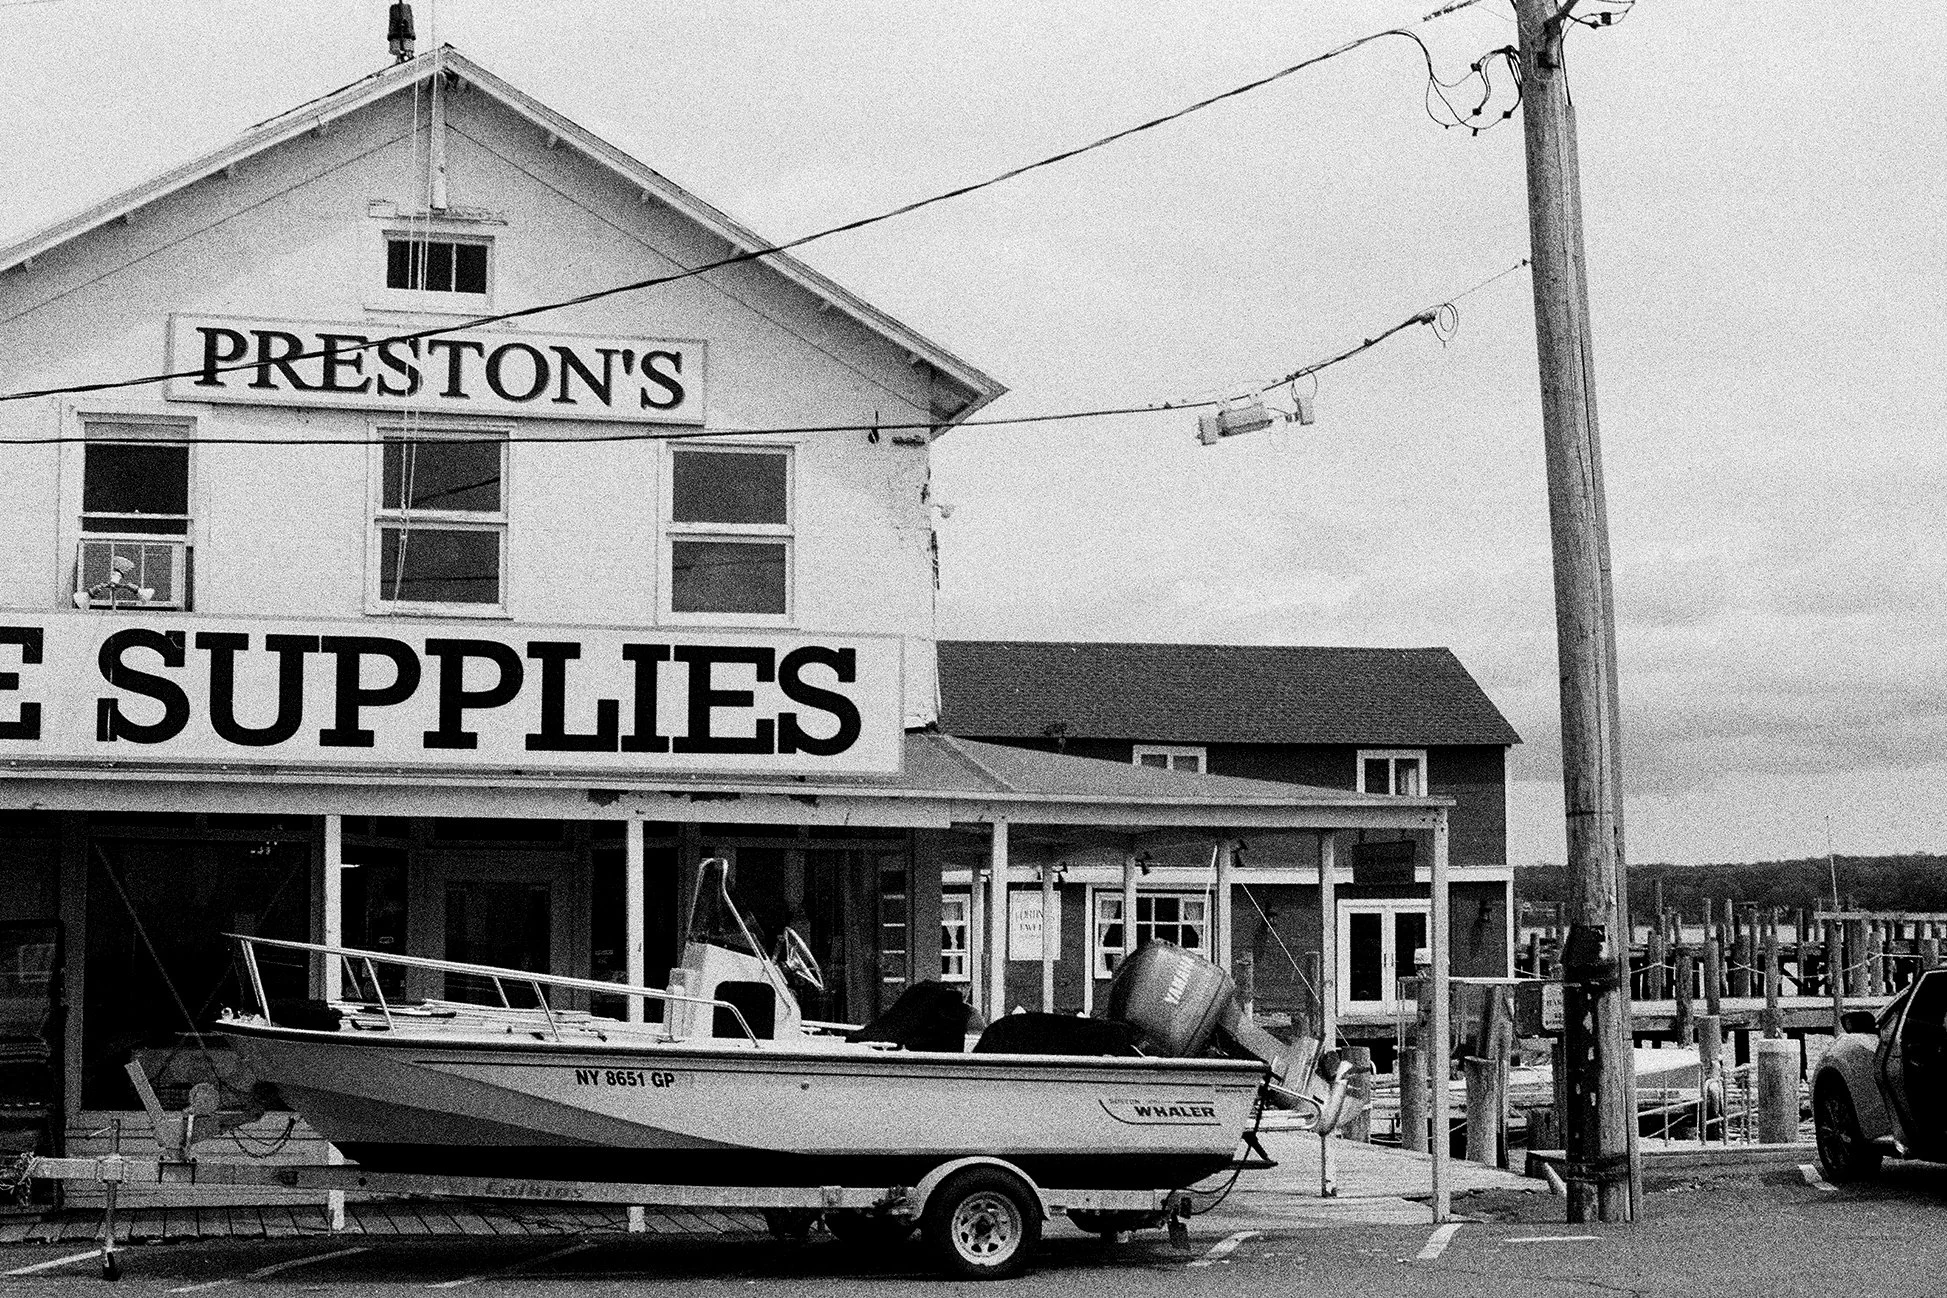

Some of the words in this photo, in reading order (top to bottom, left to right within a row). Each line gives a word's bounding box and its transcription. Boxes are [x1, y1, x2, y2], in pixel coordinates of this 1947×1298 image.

[193, 325, 685, 411] PRESTON'S
[96, 628, 862, 757] SUPPLIES
[1164, 955, 1195, 1004] YAMAHA
[575, 1069, 599, 1086] NY
[605, 1070, 645, 1087] 8651
[651, 1072, 675, 1088] GP
[1134, 1105, 1216, 1118] WHALER
